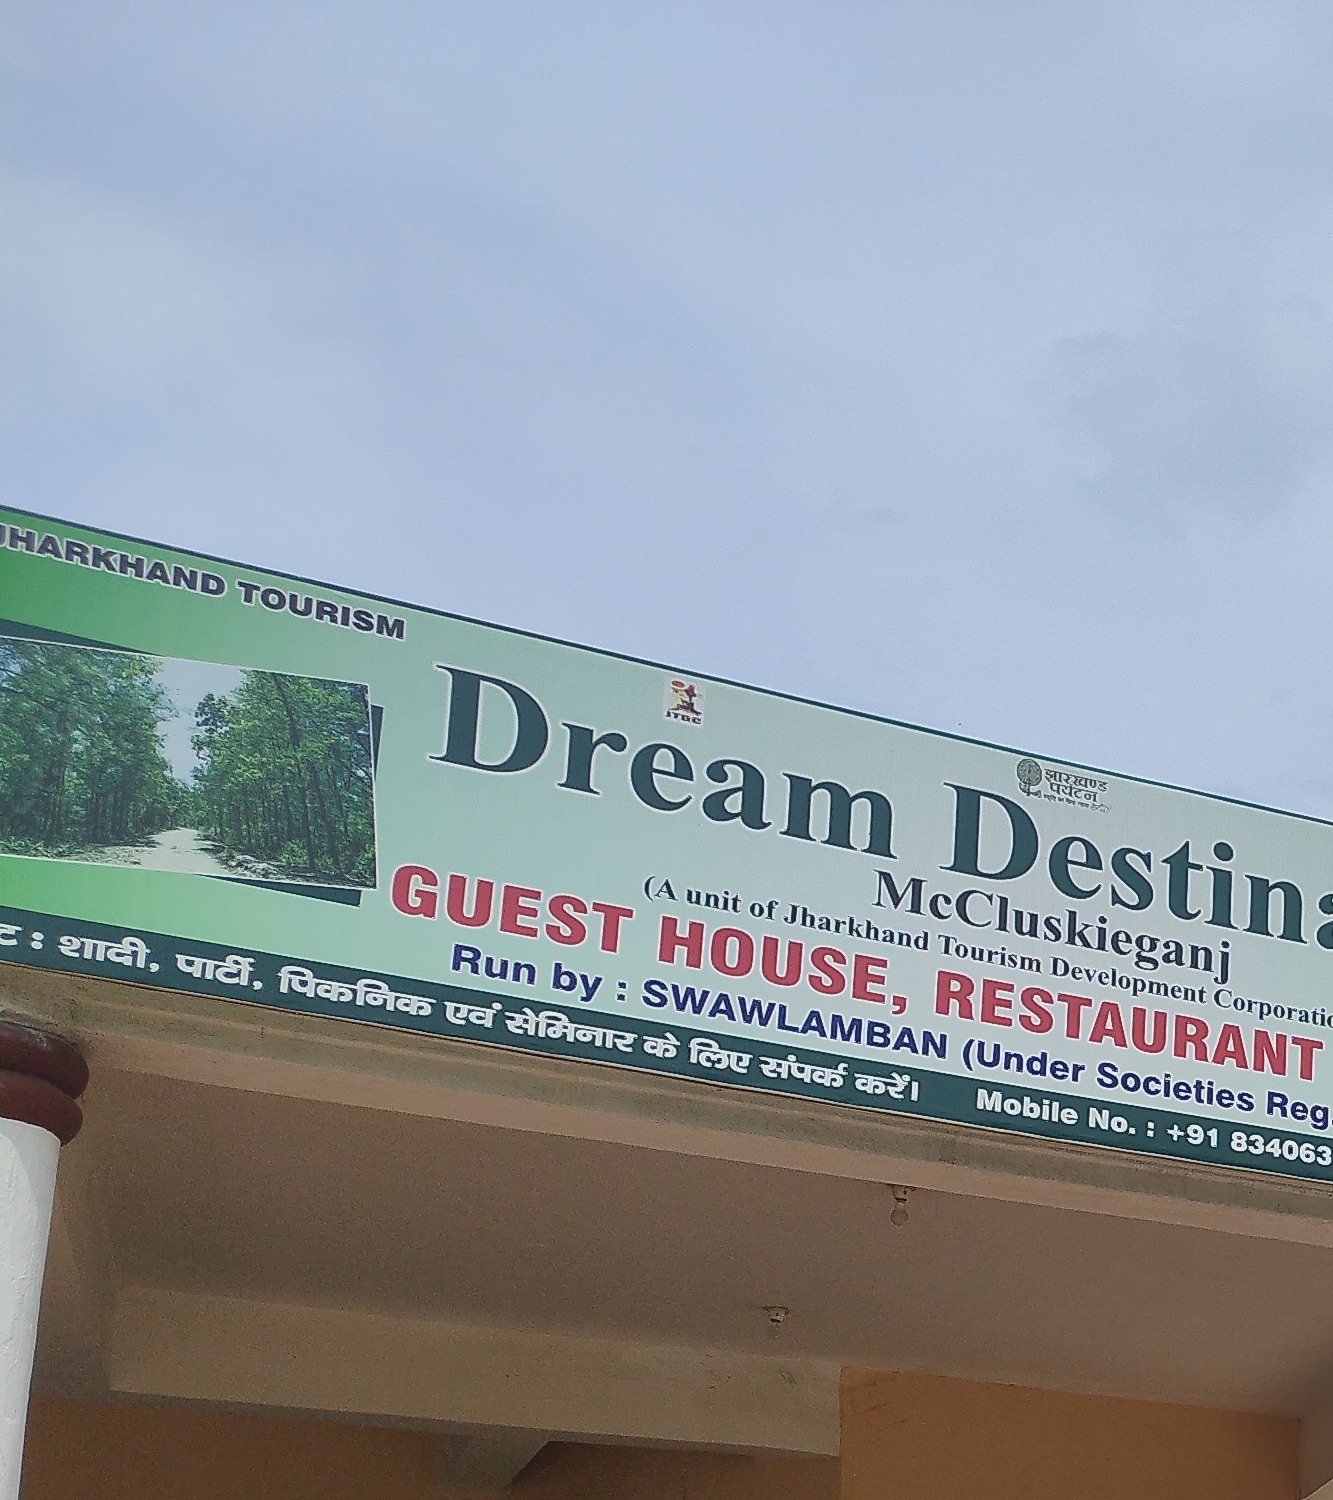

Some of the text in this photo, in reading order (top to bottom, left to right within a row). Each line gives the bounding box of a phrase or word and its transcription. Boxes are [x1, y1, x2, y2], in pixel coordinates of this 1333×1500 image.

[236, 580, 405, 640] TOURISM
[428, 662, 898, 861] Dream
[391, 863, 634, 955] GUEST
[658, 914, 908, 1016] HOUSE,
[935, 968, 1323, 1084] RESTAURANT
[644, 875, 678, 903] (A
[686, 884, 741, 916] unit
[749, 898, 780, 923] of
[783, 902, 930, 953] Jharkhand
[938, 934, 1042, 975] Tourism
[1049, 956, 1207, 1006] Development
[872, 868, 1231, 985] McCluskieganj
[0, 923, 22, 946] ट
[58, 936, 160, 973] शादी,
[175, 953, 263, 991] पार्टी,
[277, 966, 435, 1017] पिकनिक
[441, 999, 502, 1030] एवं
[503, 1006, 637, 1055] सेमिनार
[641, 1031, 679, 1061] के
[687, 1032, 752, 1074] लिए
[757, 1050, 851, 1091] संपर्क
[854, 1065, 919, 1104] करें।
[451, 942, 537, 985] Run
[552, 960, 602, 1003] by
[641, 980, 948, 1061] SWAWLAMBAN
[961, 1037, 1087, 1085] (Under
[1095, 1062, 1255, 1115] Societies
[974, 1088, 1081, 1128] Mobile
[1087, 1107, 1135, 1137] No.
[1165, 1122, 1219, 1148] +91
